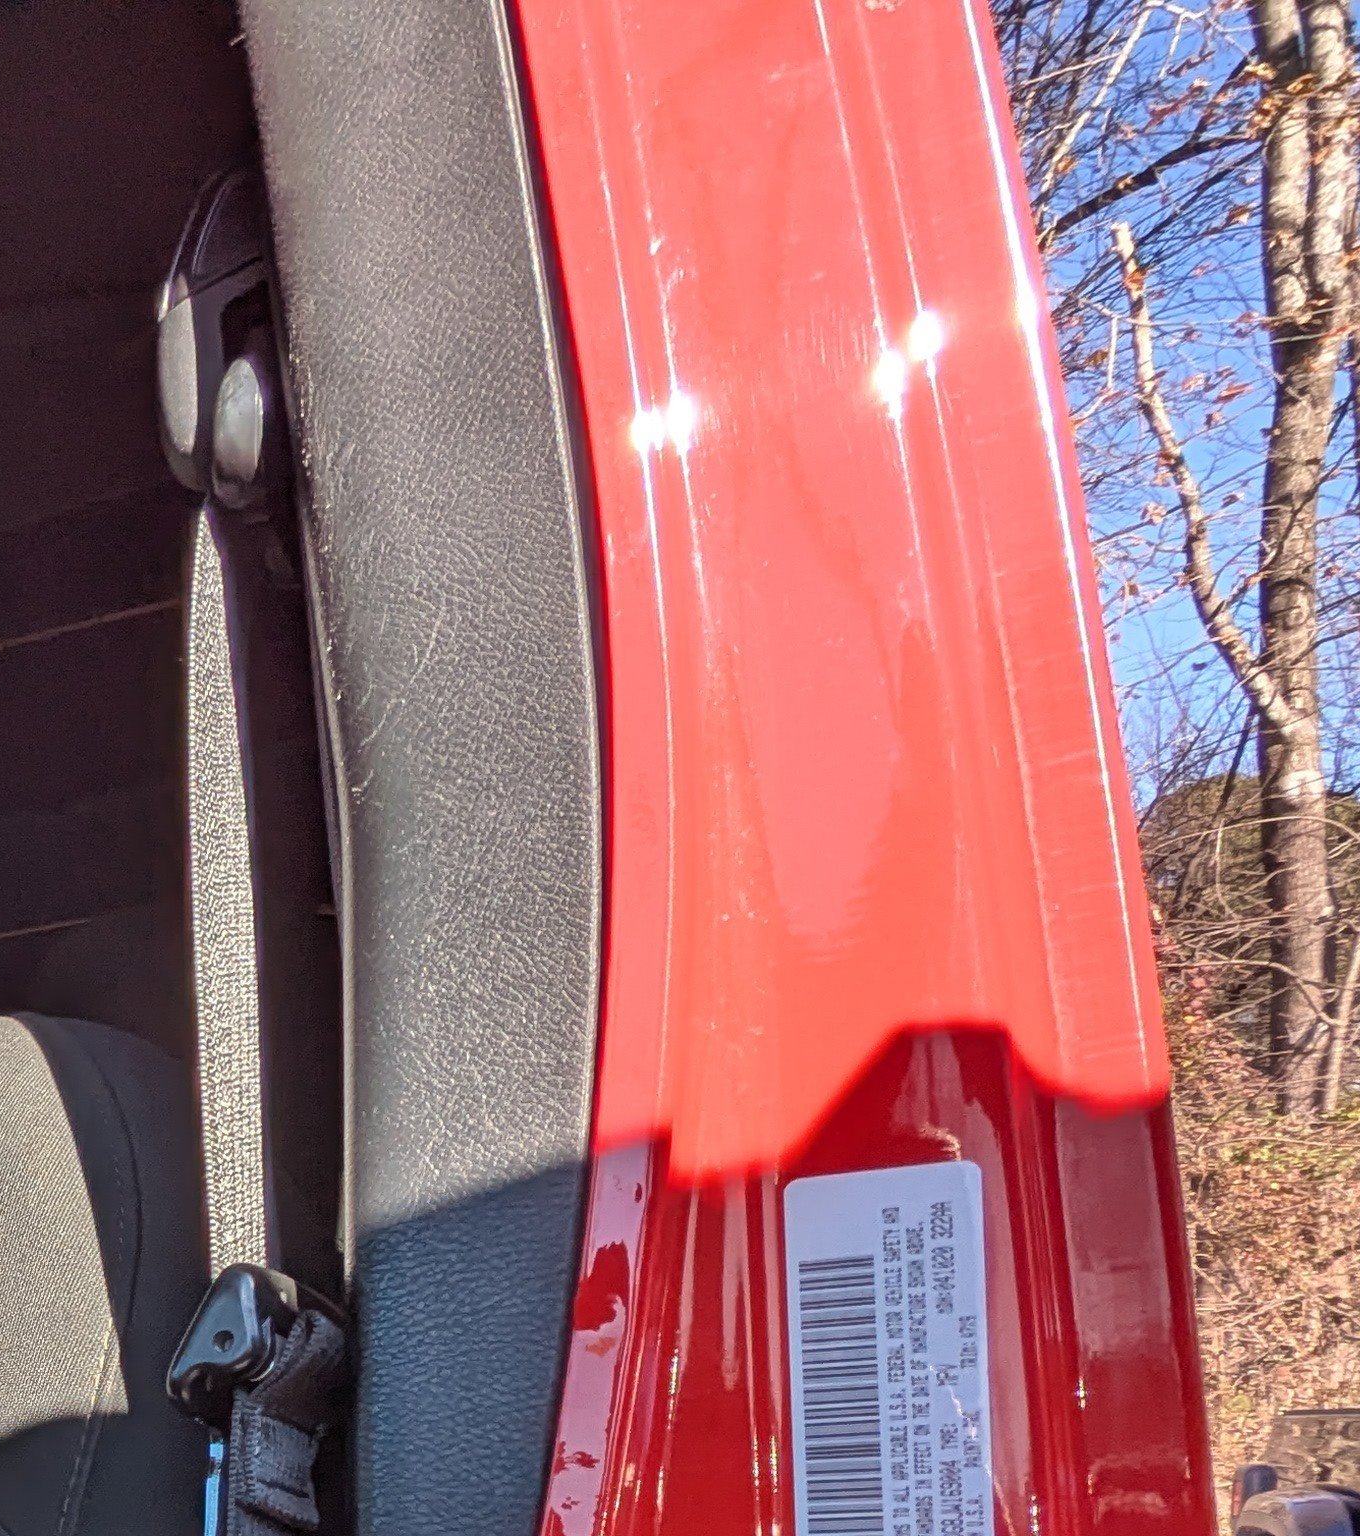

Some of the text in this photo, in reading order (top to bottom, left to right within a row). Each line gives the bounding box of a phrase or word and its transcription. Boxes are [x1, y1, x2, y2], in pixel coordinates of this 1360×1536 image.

[882, 1229, 901, 1262] SAFETY
[884, 1268, 902, 1306] VEHICLE
[885, 1311, 903, 1338] MOTOR
[887, 1344, 906, 1382] FEDERAL
[910, 1360, 928, 1370] OF
[936, 1364, 958, 1386] MPV
[910, 1376, 929, 1397] DATE
[889, 1388, 906, 1420] U.S.A.
[912, 1403, 930, 1418] THE
[889, 1426, 908, 1480] APPLICABLE
[914, 1442, 932, 1474] EFFECT
[892, 1486, 910, 1502] ALL
[892, 1507, 910, 1518] TO
